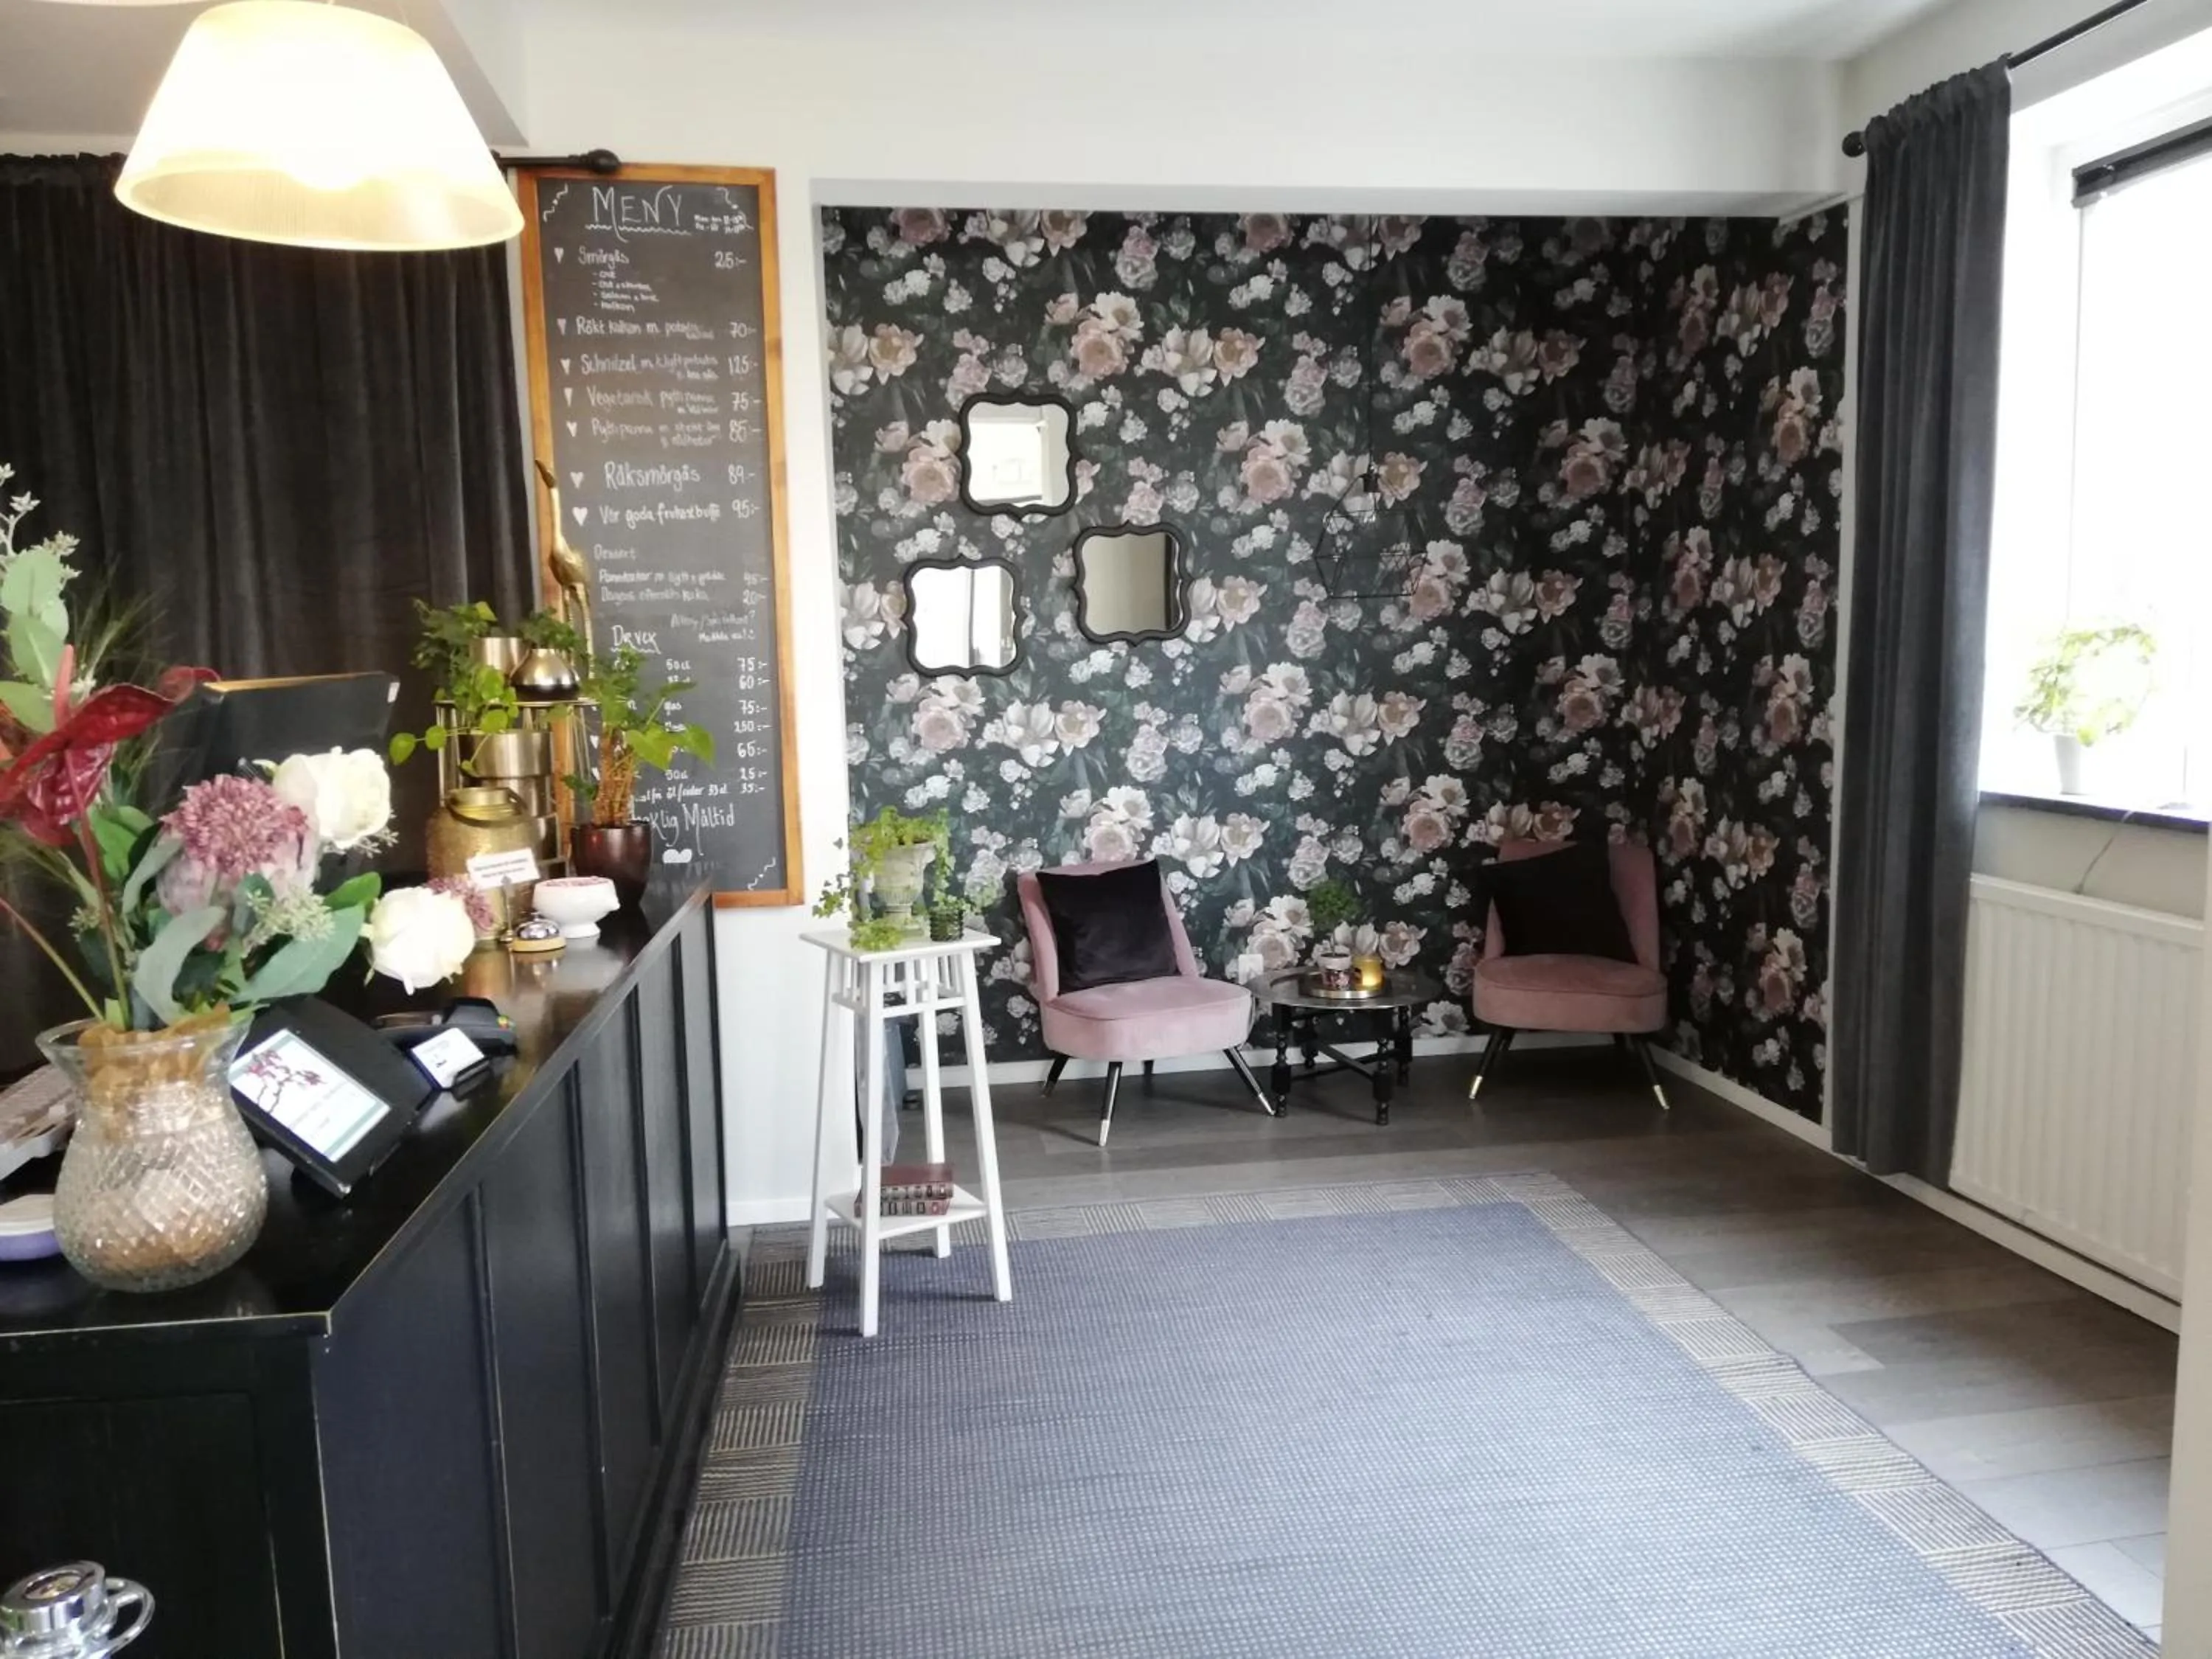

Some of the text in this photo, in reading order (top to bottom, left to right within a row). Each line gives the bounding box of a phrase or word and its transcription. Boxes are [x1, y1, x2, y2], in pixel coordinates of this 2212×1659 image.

[592, 185, 682, 243] MENY
[578, 246, 747, 270] Smörgås 25:-
[576, 316, 605, 335] Rökt
[580, 352, 636, 375] Schnitzel
[604, 460, 700, 492] Räksmörgås
[625, 505, 655, 530] goda
[731, 498, 762, 518] 95:-
[737, 657, 768, 672] 75:-
[739, 675, 771, 689] 60:-
[738, 700, 768, 714] 75:-
[681, 802, 734, 856] Måltid
